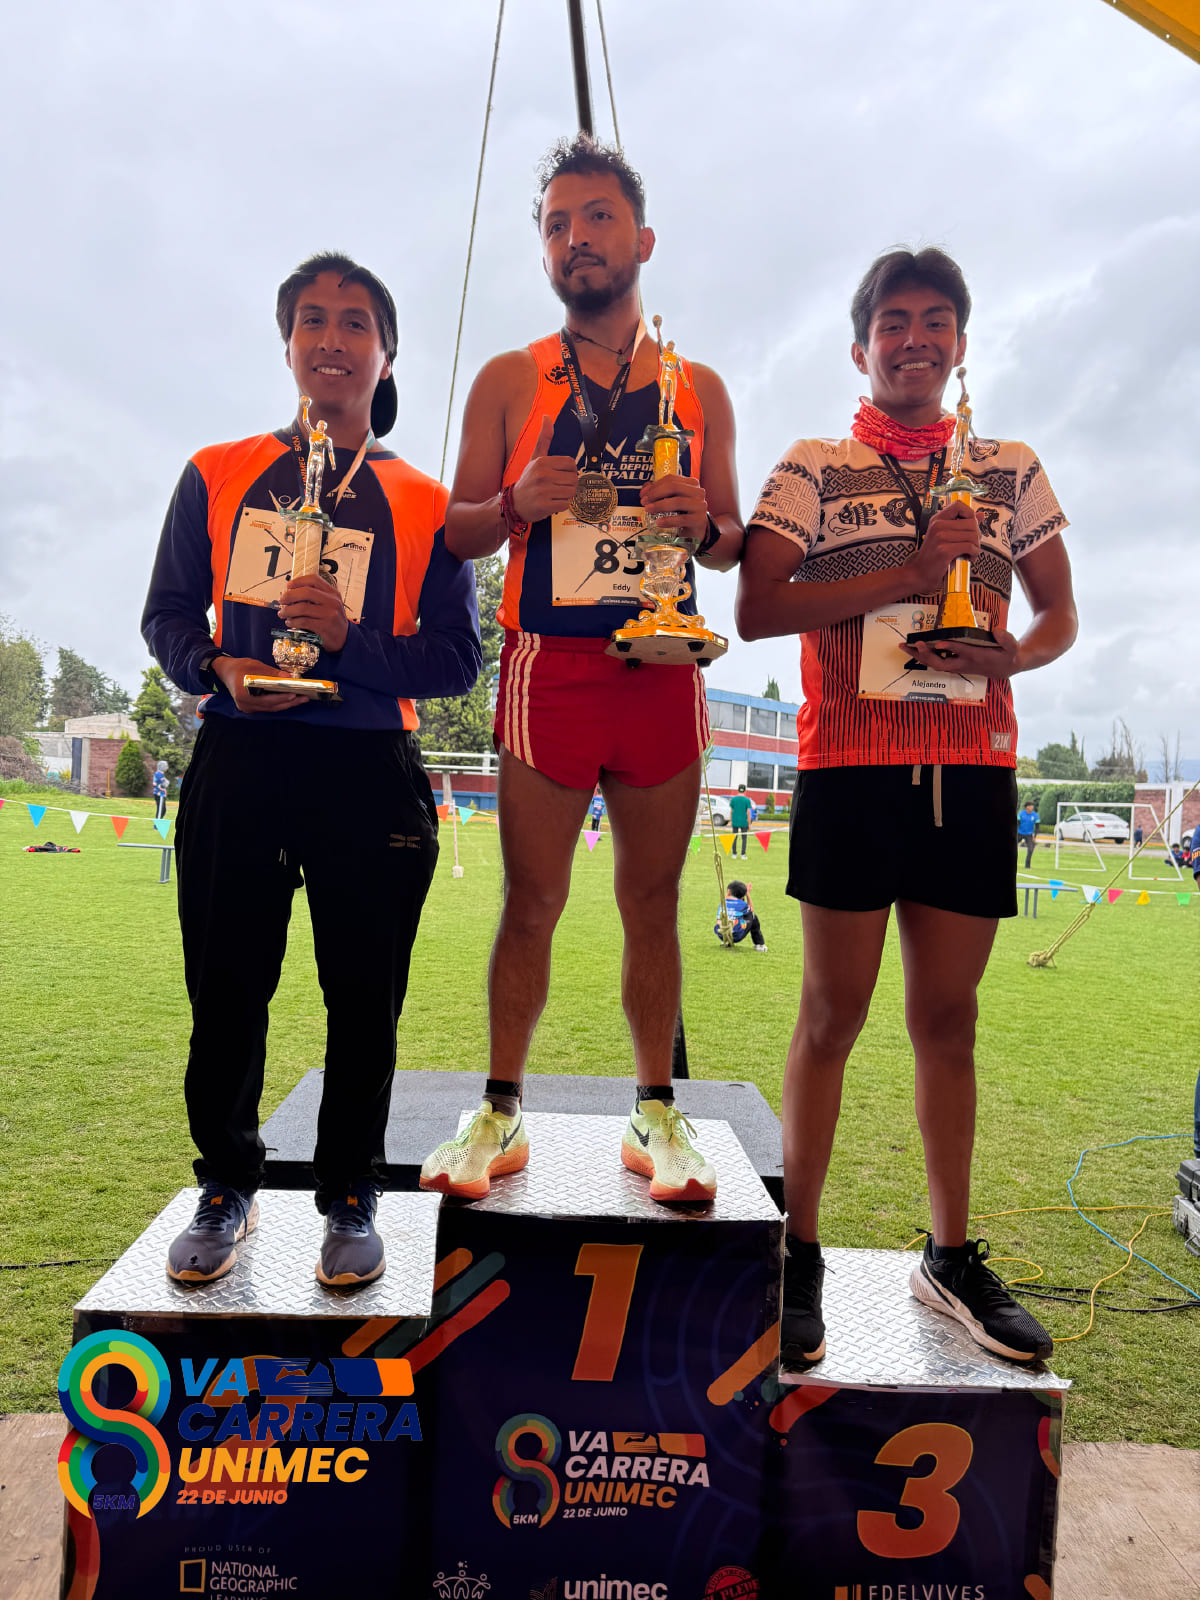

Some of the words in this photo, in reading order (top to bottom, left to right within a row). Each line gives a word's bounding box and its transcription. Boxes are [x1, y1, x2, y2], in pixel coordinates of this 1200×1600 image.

[567, 363, 581, 393] UNIMEC
[612, 583, 631, 593] Eddy
[911, 679, 946, 690] Alejandro
[994, 734, 1010, 749] 21K
[571, 1243, 644, 1382] 1
[568, 1430, 609, 1453] VA
[564, 1455, 710, 1488] CARRERA
[563, 1481, 678, 1509] UNIMEC
[856, 1421, 975, 1560] 3
[512, 1513, 539, 1525] 5KM
[562, 1509, 576, 1519] 22
[577, 1508, 592, 1518] DE
[593, 1506, 628, 1517] JUNIO
[211, 1561, 279, 1578] NATIONAL
[209, 1576, 298, 1593] GEOGRAPHIC
[564, 1573, 668, 1600] unimec
